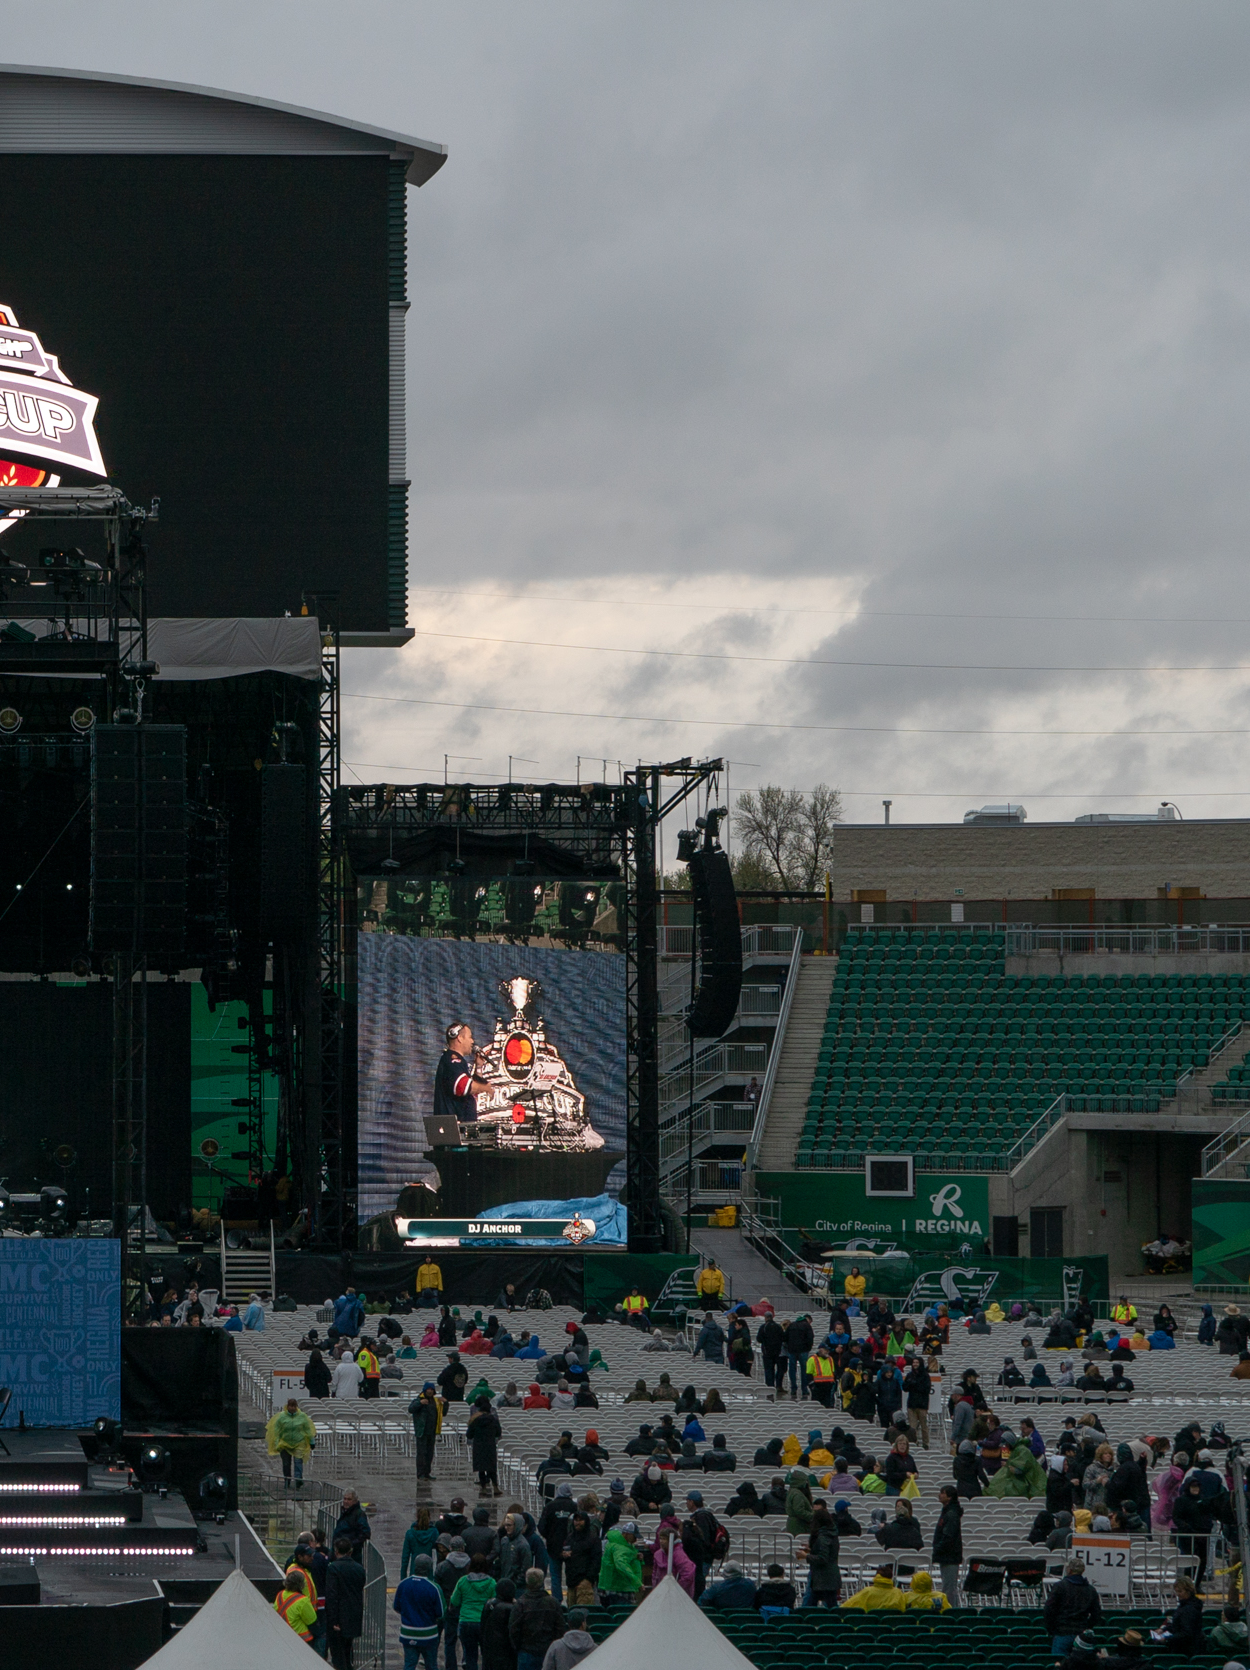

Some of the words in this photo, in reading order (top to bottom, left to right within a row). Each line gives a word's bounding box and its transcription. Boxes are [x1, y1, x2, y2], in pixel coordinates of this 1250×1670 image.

[467, 1223, 480, 1234] DJ
[815, 1219, 838, 1231] City
[840, 1219, 852, 1231] of
[854, 1221, 892, 1233] Regina
[916, 1219, 983, 1235] REGINA
[87, 1270, 118, 1281] ONLY
[87, 1306, 110, 1359] REGINA
[87, 1360, 118, 1371] ONLY
[280, 1378, 306, 1390] FL-5
[1075, 1550, 1127, 1567] FL-12
